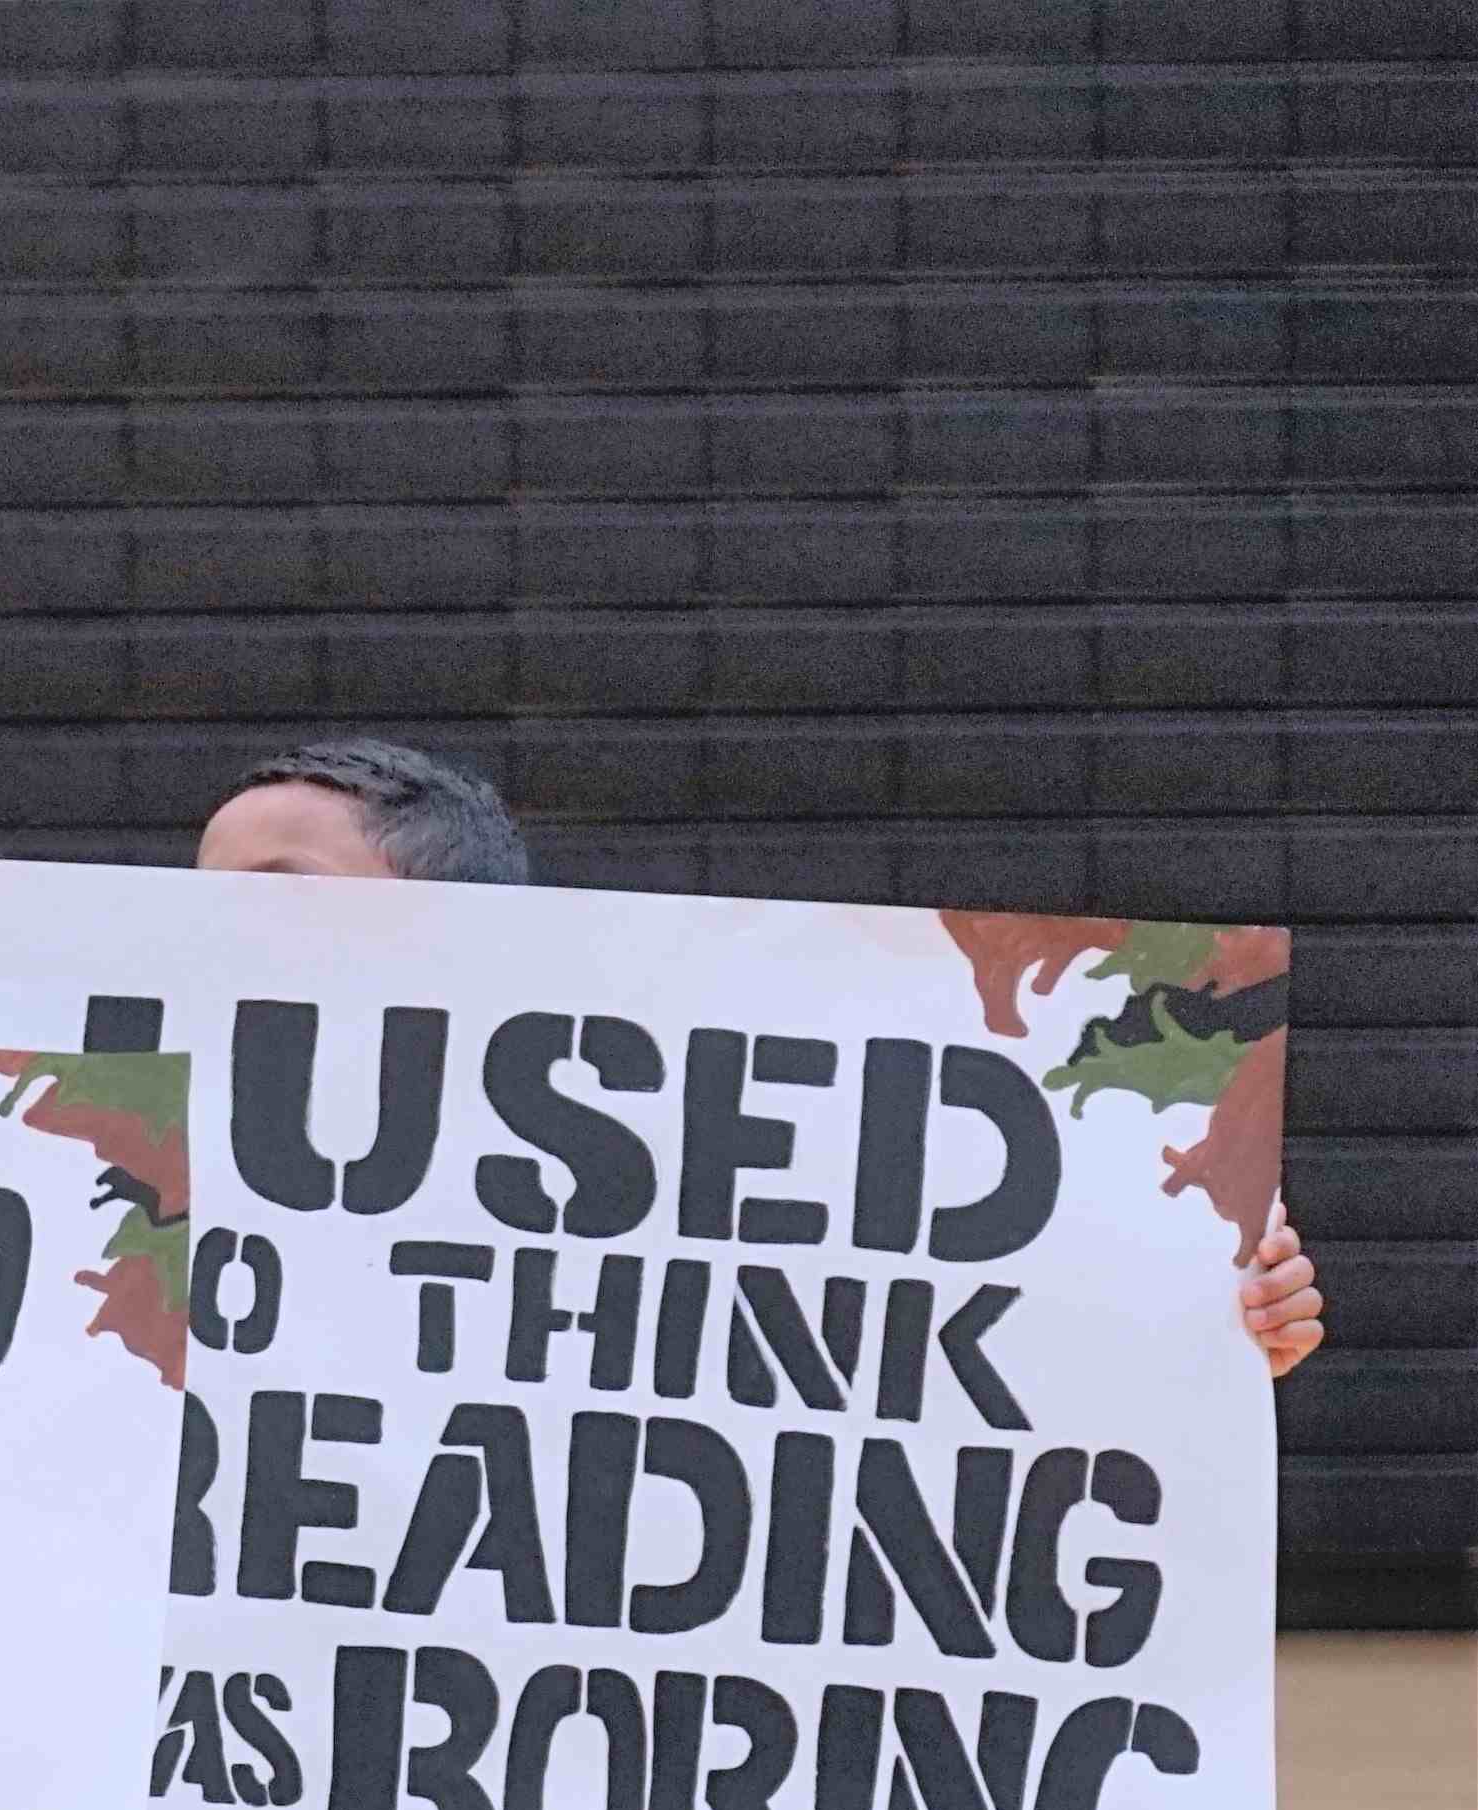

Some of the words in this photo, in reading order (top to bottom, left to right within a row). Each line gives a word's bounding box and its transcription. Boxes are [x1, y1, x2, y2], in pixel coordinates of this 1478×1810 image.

[229, 998, 1062, 1264] USED
[389, 1241, 1032, 1431] THINK
[150, 1671, 302, 1806] AS
